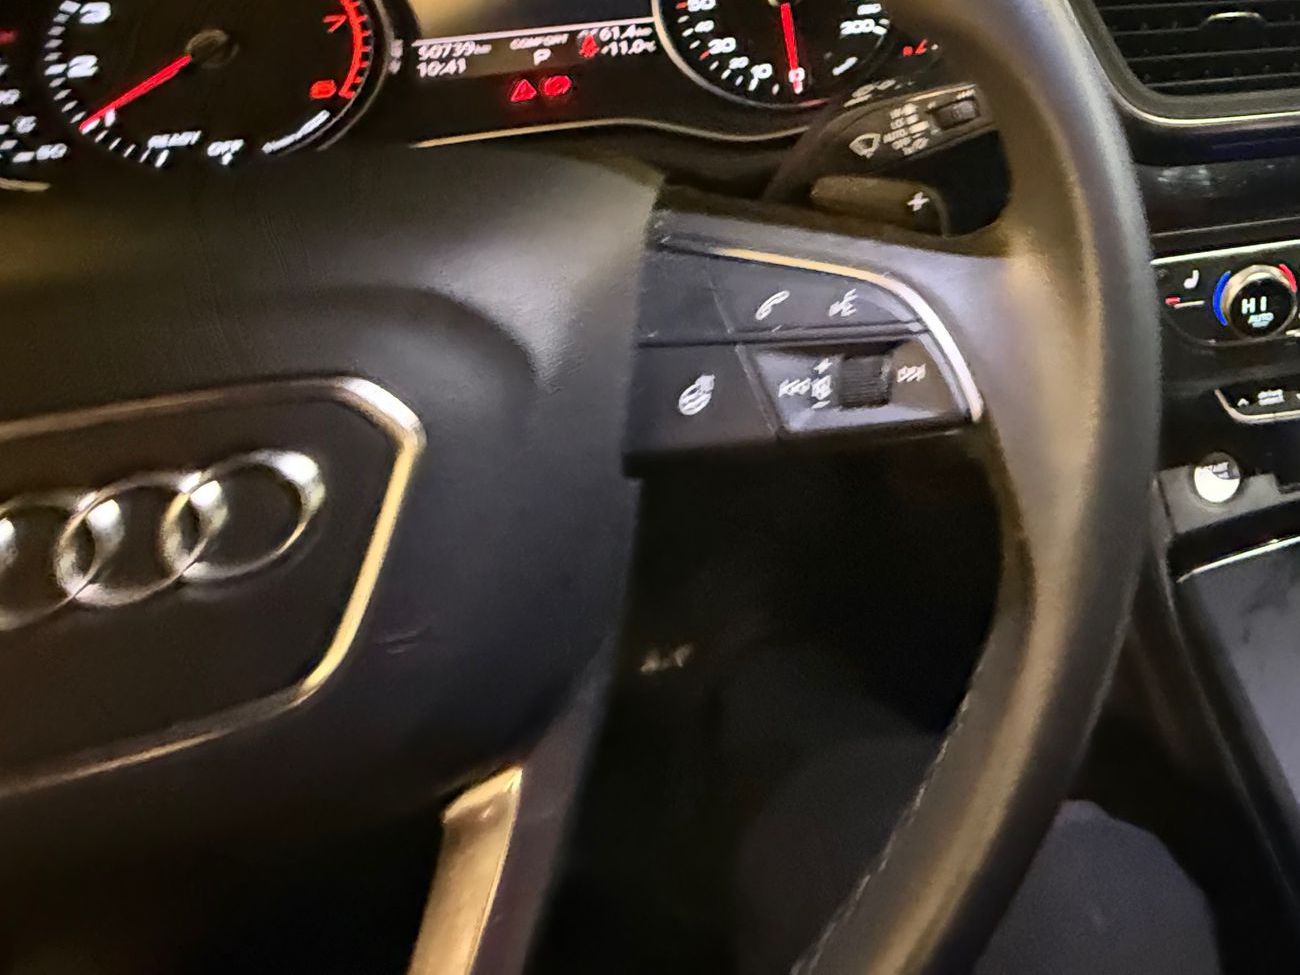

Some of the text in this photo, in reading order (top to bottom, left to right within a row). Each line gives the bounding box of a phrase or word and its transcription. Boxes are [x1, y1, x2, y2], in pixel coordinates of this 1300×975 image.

[79, 2, 111, 24] 3
[322, 15, 348, 33] 7
[510, 33, 569, 50] COMFORT
[708, 37, 737, 54] 30
[533, 48, 551, 65] P
[67, 55, 98, 78] 2
[416, 58, 467, 78] 10:41
[1241, 296, 1267, 314] HI
